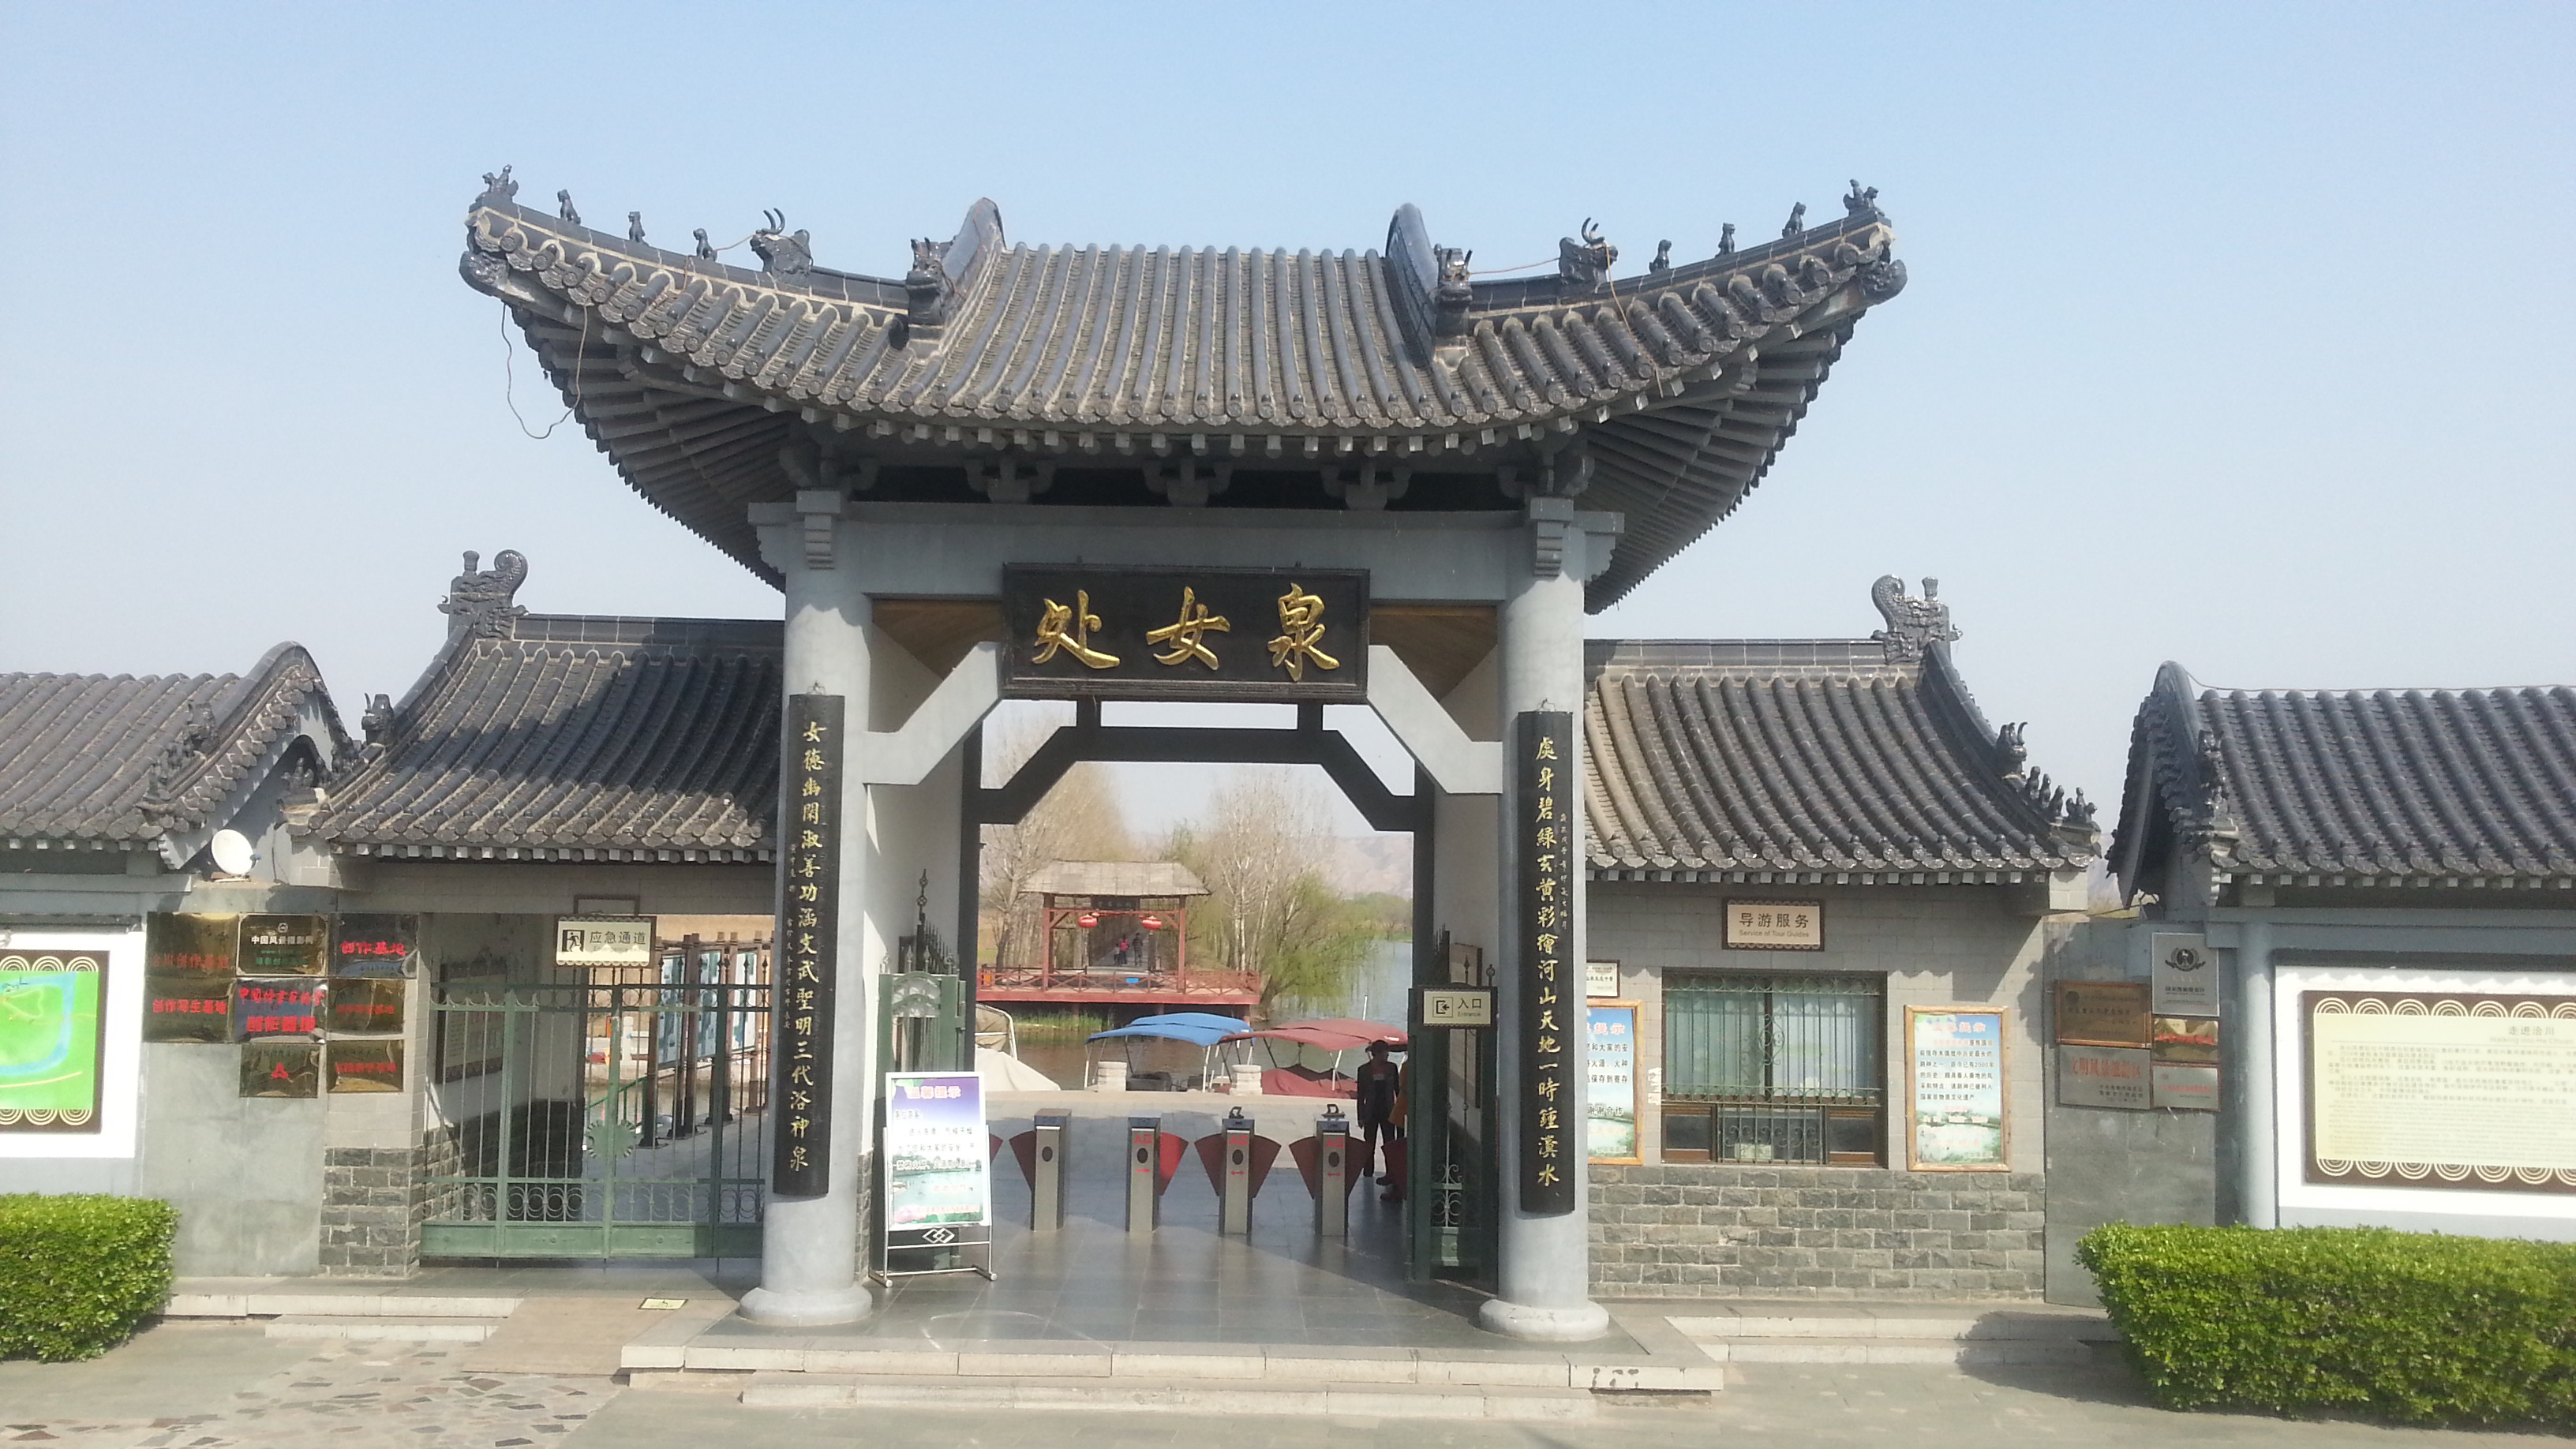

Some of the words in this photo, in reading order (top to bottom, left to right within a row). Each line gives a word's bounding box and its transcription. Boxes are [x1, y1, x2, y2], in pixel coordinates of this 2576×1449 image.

[1739, 913, 1809, 928] 导游服务
[590, 930, 646, 945] 应急通道
[1458, 998, 1481, 1009] 入口
[1134, 1134, 1151, 1144] 入口
[1229, 1135, 1248, 1145] 入口
[1326, 1138, 1343, 1148] 入口
